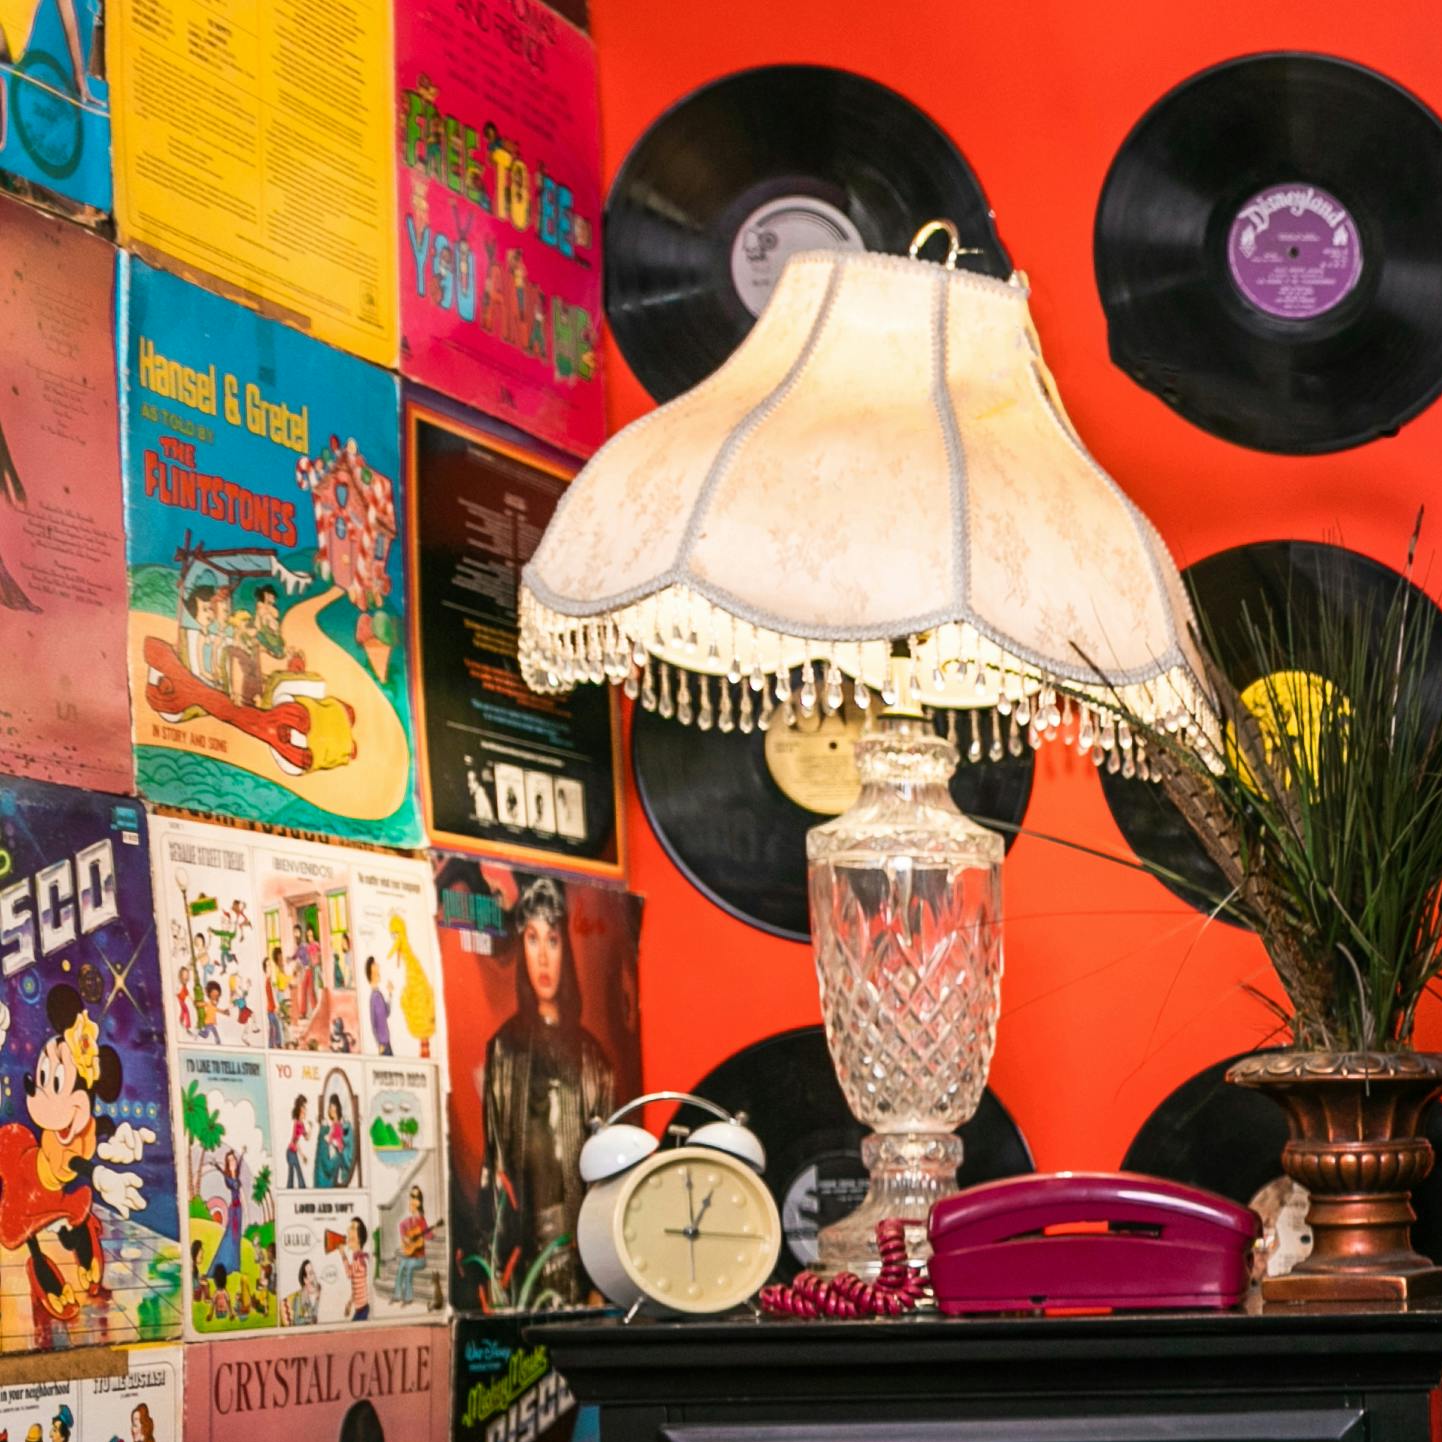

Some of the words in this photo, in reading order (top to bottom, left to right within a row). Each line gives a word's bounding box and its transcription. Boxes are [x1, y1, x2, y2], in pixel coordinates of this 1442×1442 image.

[403, 90, 490, 212] FREE
[490, 148, 529, 231] TO
[1238, 187, 1345, 234] Disneyland
[406, 214, 475, 322] YOU
[140, 334, 217, 416] Hansel
[223, 373, 242, 426] &
[245, 383, 309, 455] Gretel
[159, 436, 196, 470] THE
[144, 448, 298, 549] FLINTSTONES
[162, 726, 187, 743] STORY
[189, 731, 206, 749] AND
[207, 736, 228, 754] SONG
[275, 1064, 292, 1078] YO
[301, 1065, 320, 1080] ME
[214, 1354, 341, 1416] CRYSTAL
[348, 1346, 431, 1400] GAYLE
